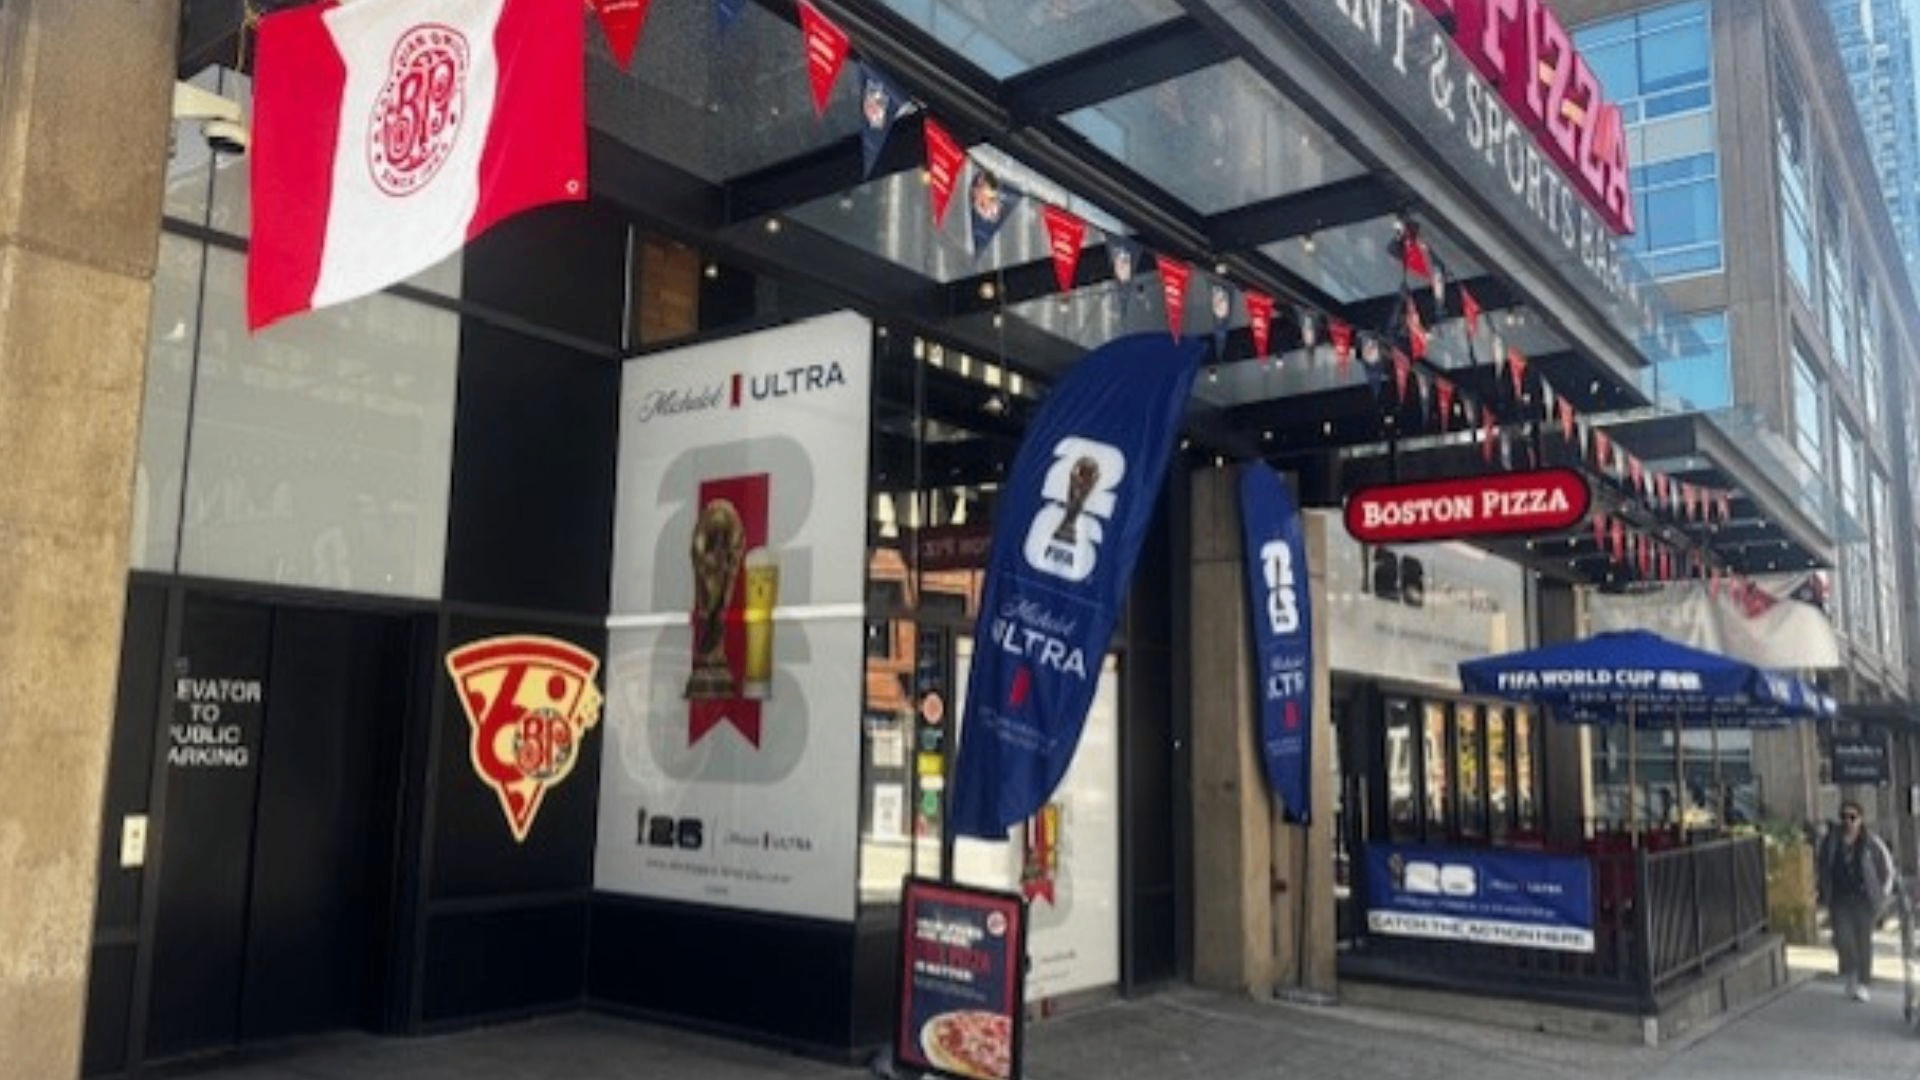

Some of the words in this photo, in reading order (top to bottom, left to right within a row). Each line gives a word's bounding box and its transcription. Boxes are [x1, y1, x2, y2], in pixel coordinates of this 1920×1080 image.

[1430, 33, 1455, 123] &
[1466, 71, 1576, 250] SPORTS
[751, 361, 845, 401] ULTRA
[1361, 496, 1474, 529] BOSTON
[1481, 487, 1570, 518] PIZZA
[1497, 673, 1538, 690] FIFA
[1541, 671, 1612, 687] WORLD
[1615, 671, 1656, 687] CUP
[191, 704, 220, 722] TO
